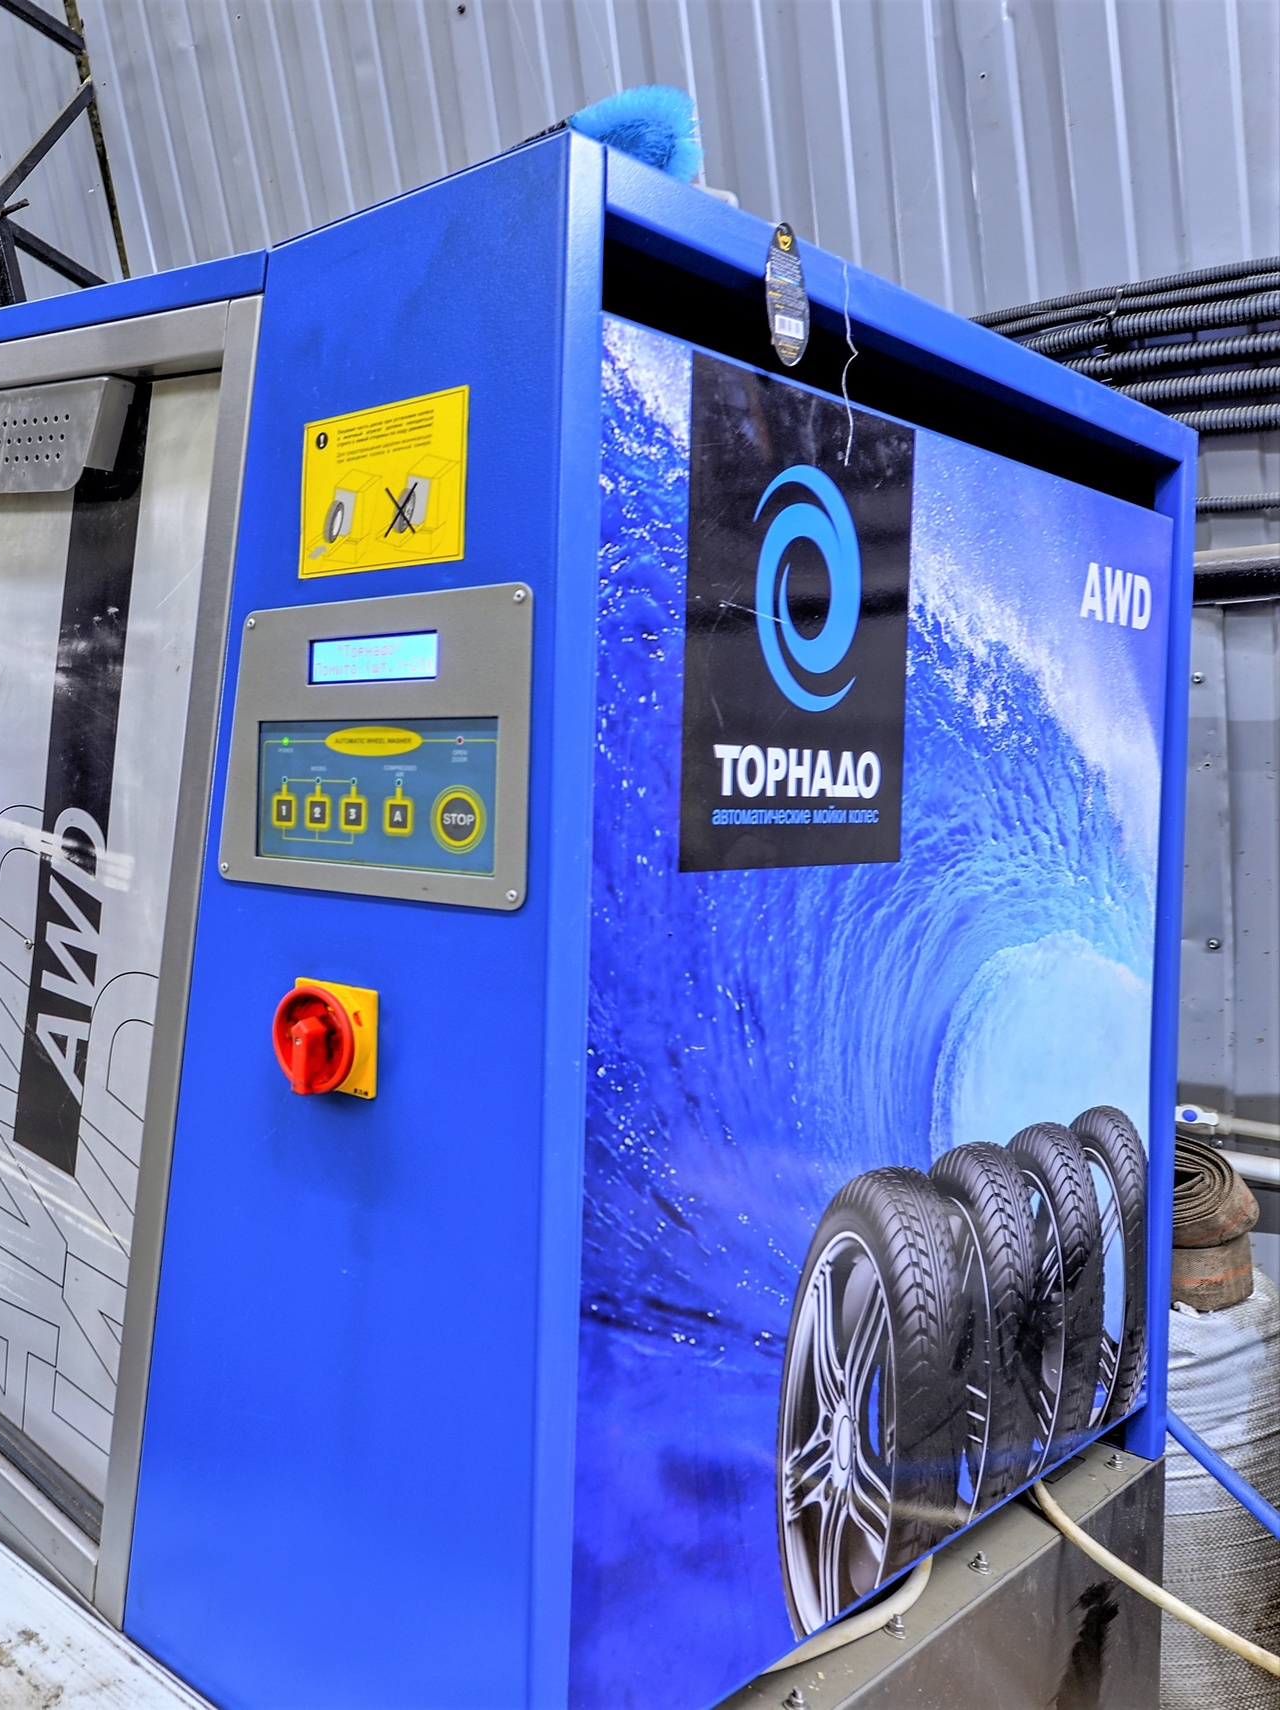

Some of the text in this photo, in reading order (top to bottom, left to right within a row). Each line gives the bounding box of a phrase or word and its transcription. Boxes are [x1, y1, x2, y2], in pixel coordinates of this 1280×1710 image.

[1080, 562, 1152, 630] AWD
[713, 744, 882, 799] ТОРНАДО
[281, 805, 287, 816] 1
[313, 807, 321, 818] 2
[348, 808, 356, 820] 3
[393, 811, 402, 822] A
[712, 805, 880, 826] автоматические мойки колес
[442, 812, 475, 826] STOP
[36, 806, 107, 1107] AWD
